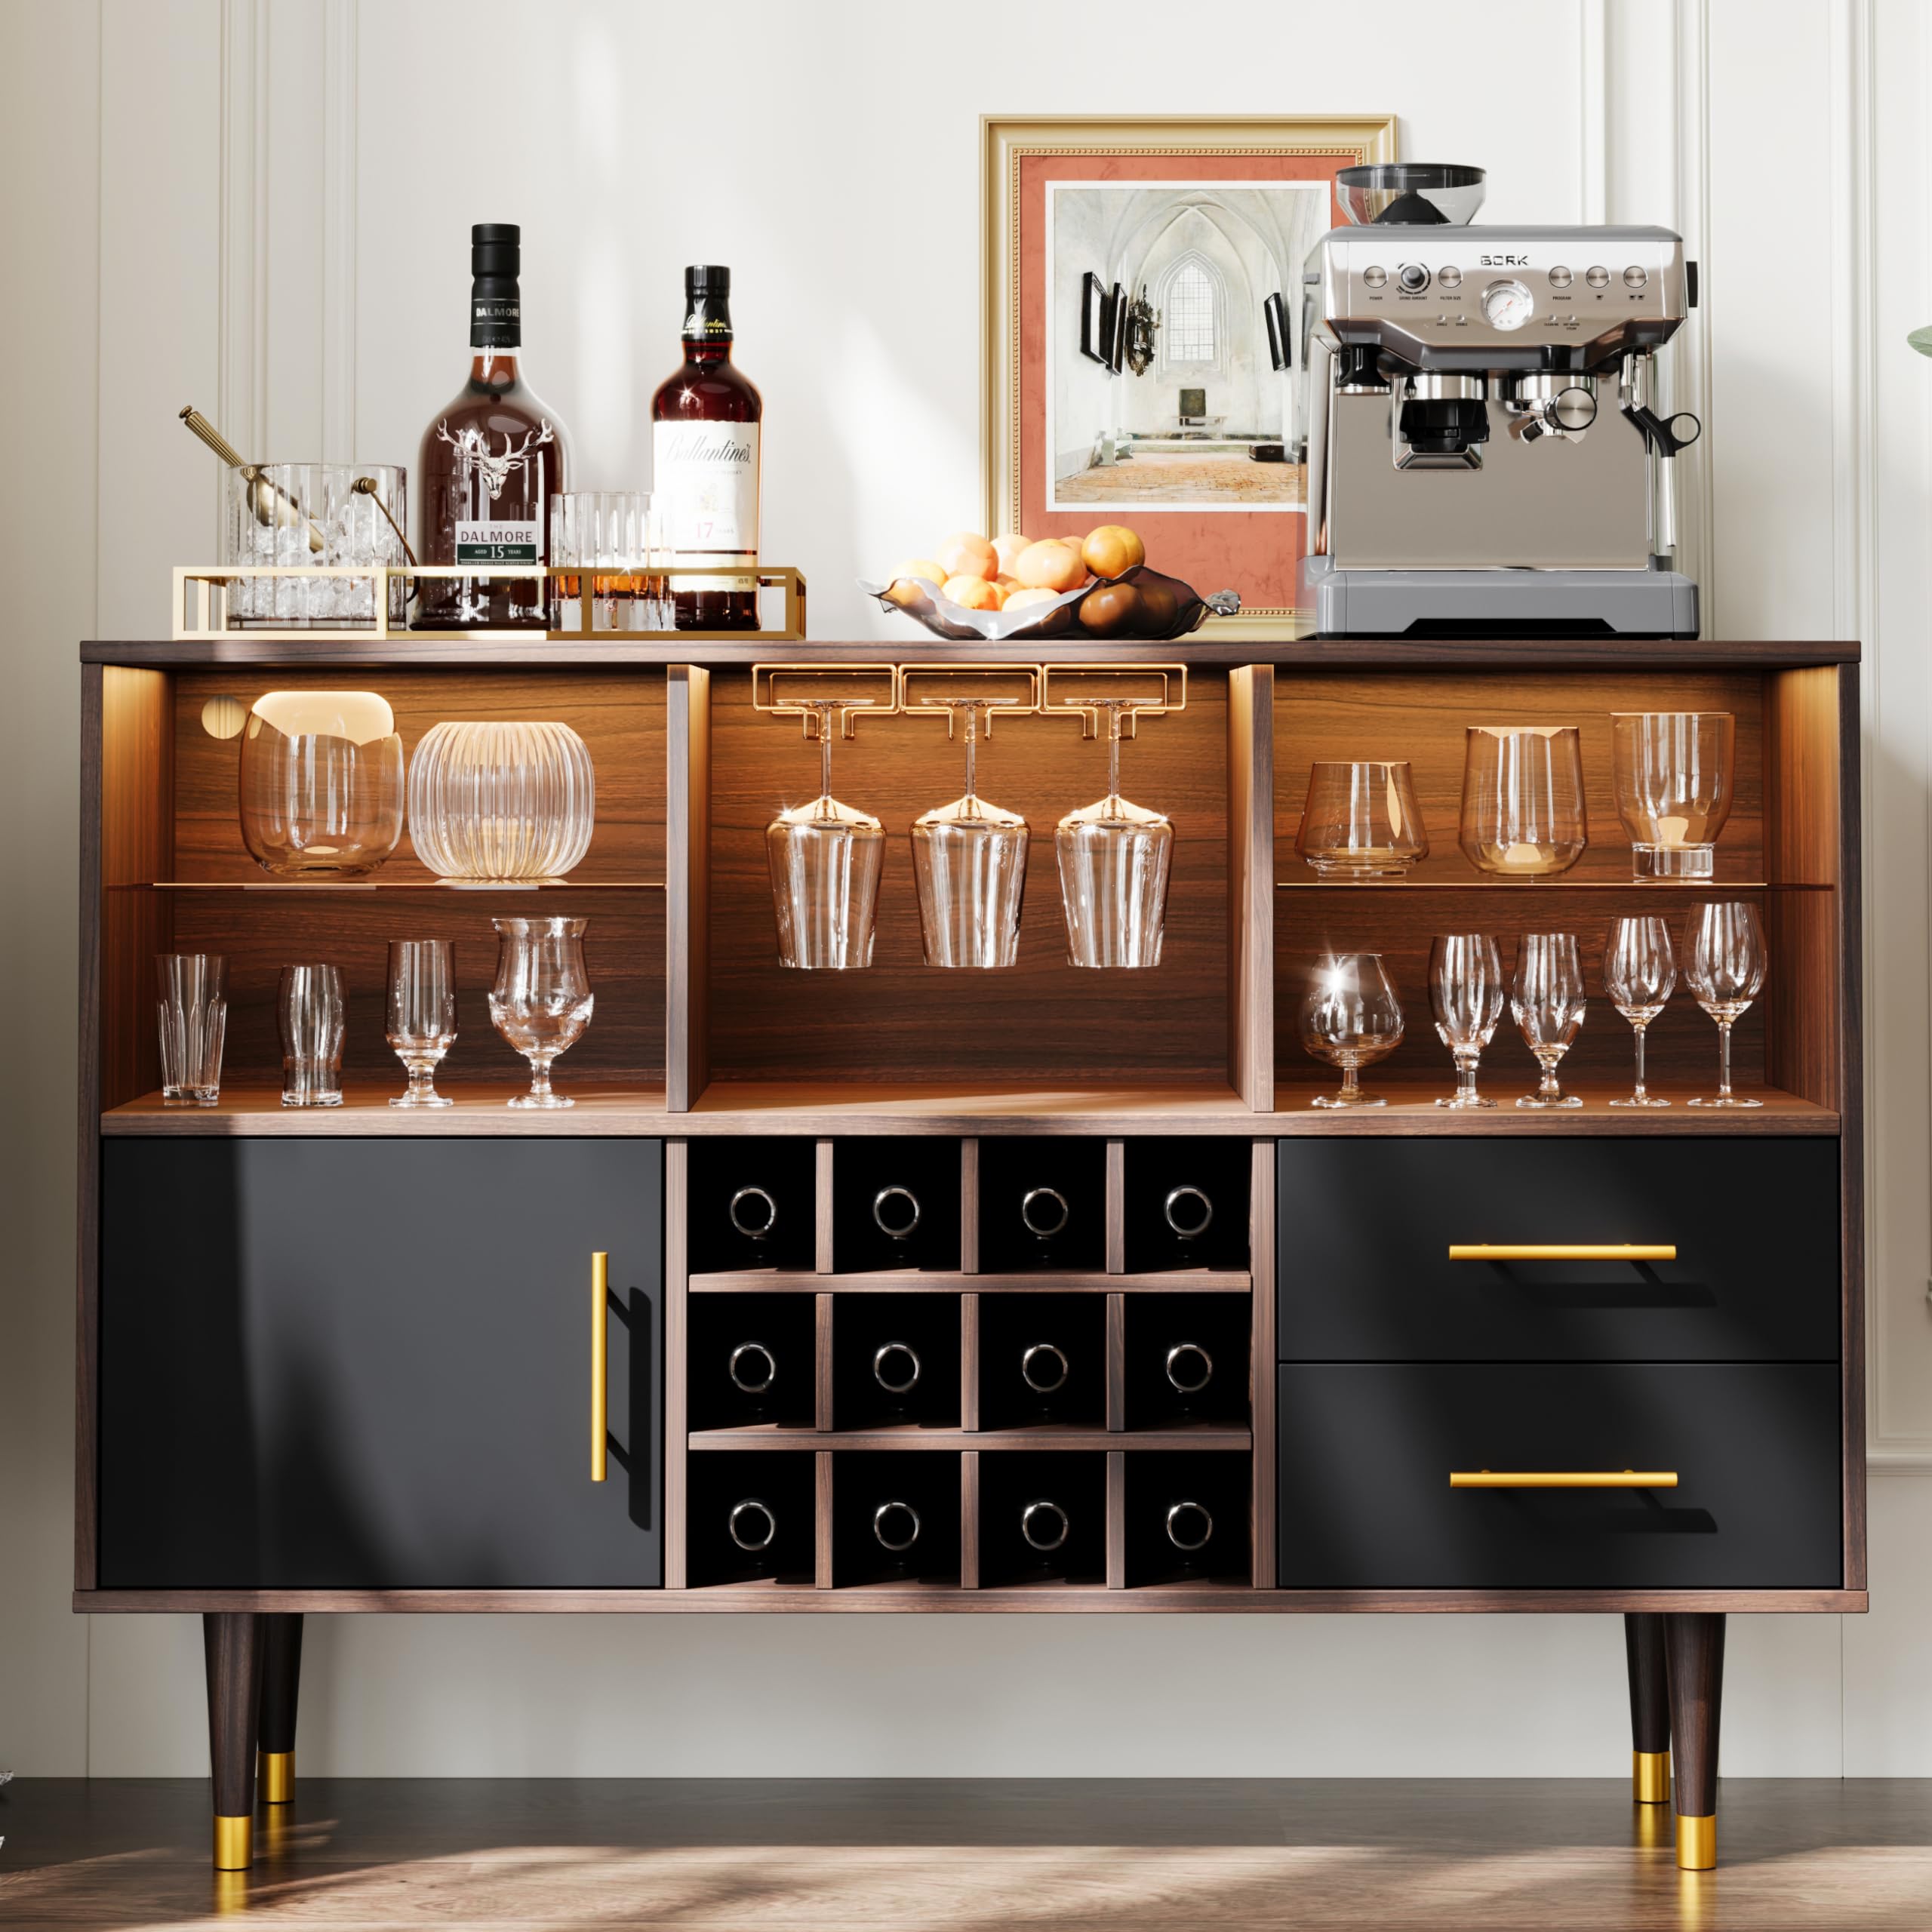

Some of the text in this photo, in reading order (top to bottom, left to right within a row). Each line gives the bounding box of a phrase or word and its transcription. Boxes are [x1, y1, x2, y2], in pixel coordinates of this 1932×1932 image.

[475, 307, 520, 317] DALMORE
[696, 522, 713, 538] 17
[461, 531, 533, 543] DALMORE
[491, 546, 505, 558] 15
